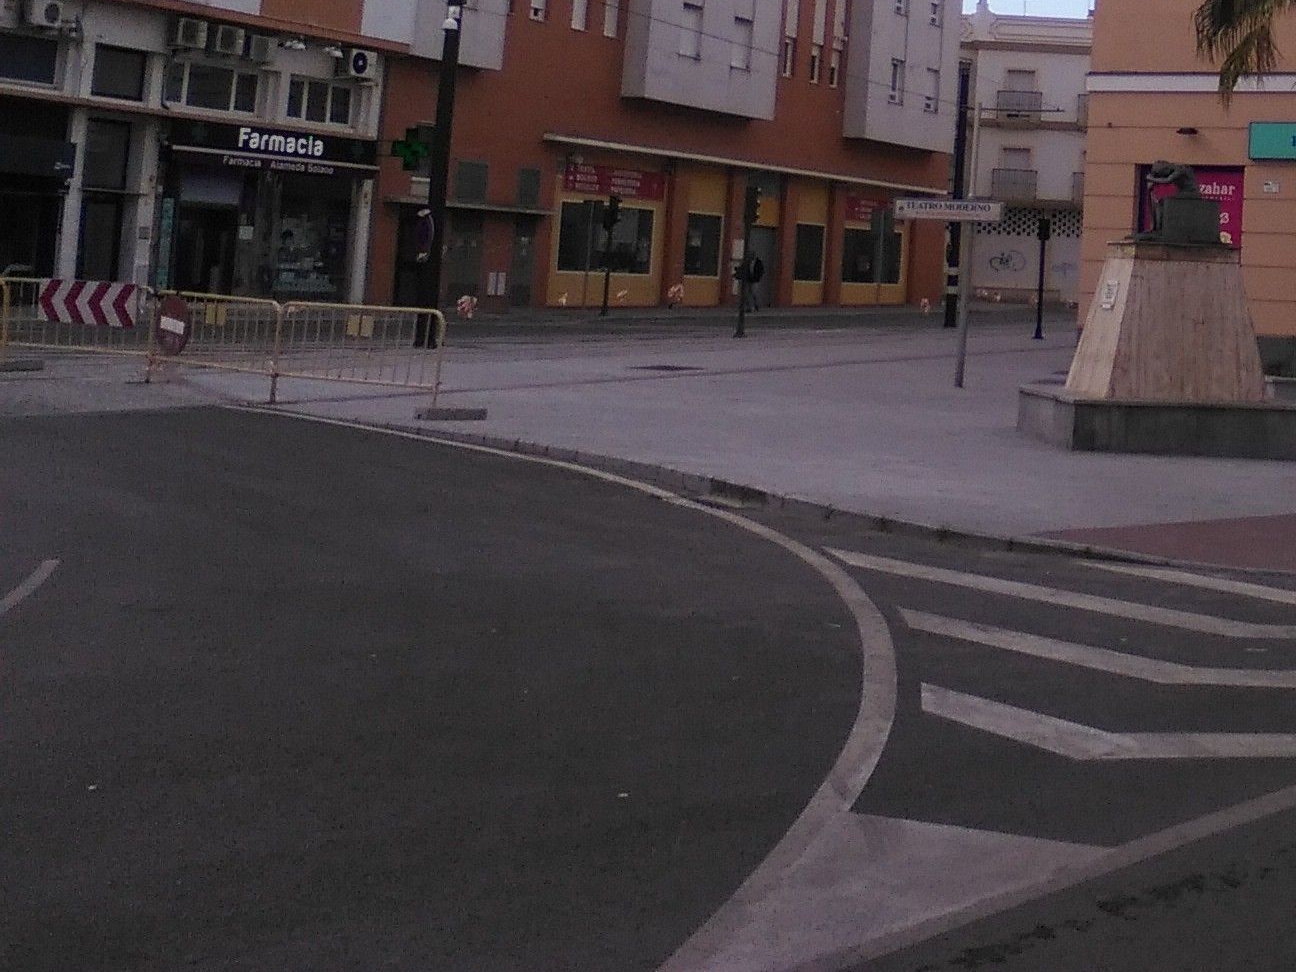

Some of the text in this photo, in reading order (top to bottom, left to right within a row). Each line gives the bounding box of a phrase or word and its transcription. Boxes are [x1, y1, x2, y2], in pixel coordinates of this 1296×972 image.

[238, 127, 324, 157] Farmacia
[222, 156, 262, 168] Farmacia
[1199, 182, 1236, 196] zahar
